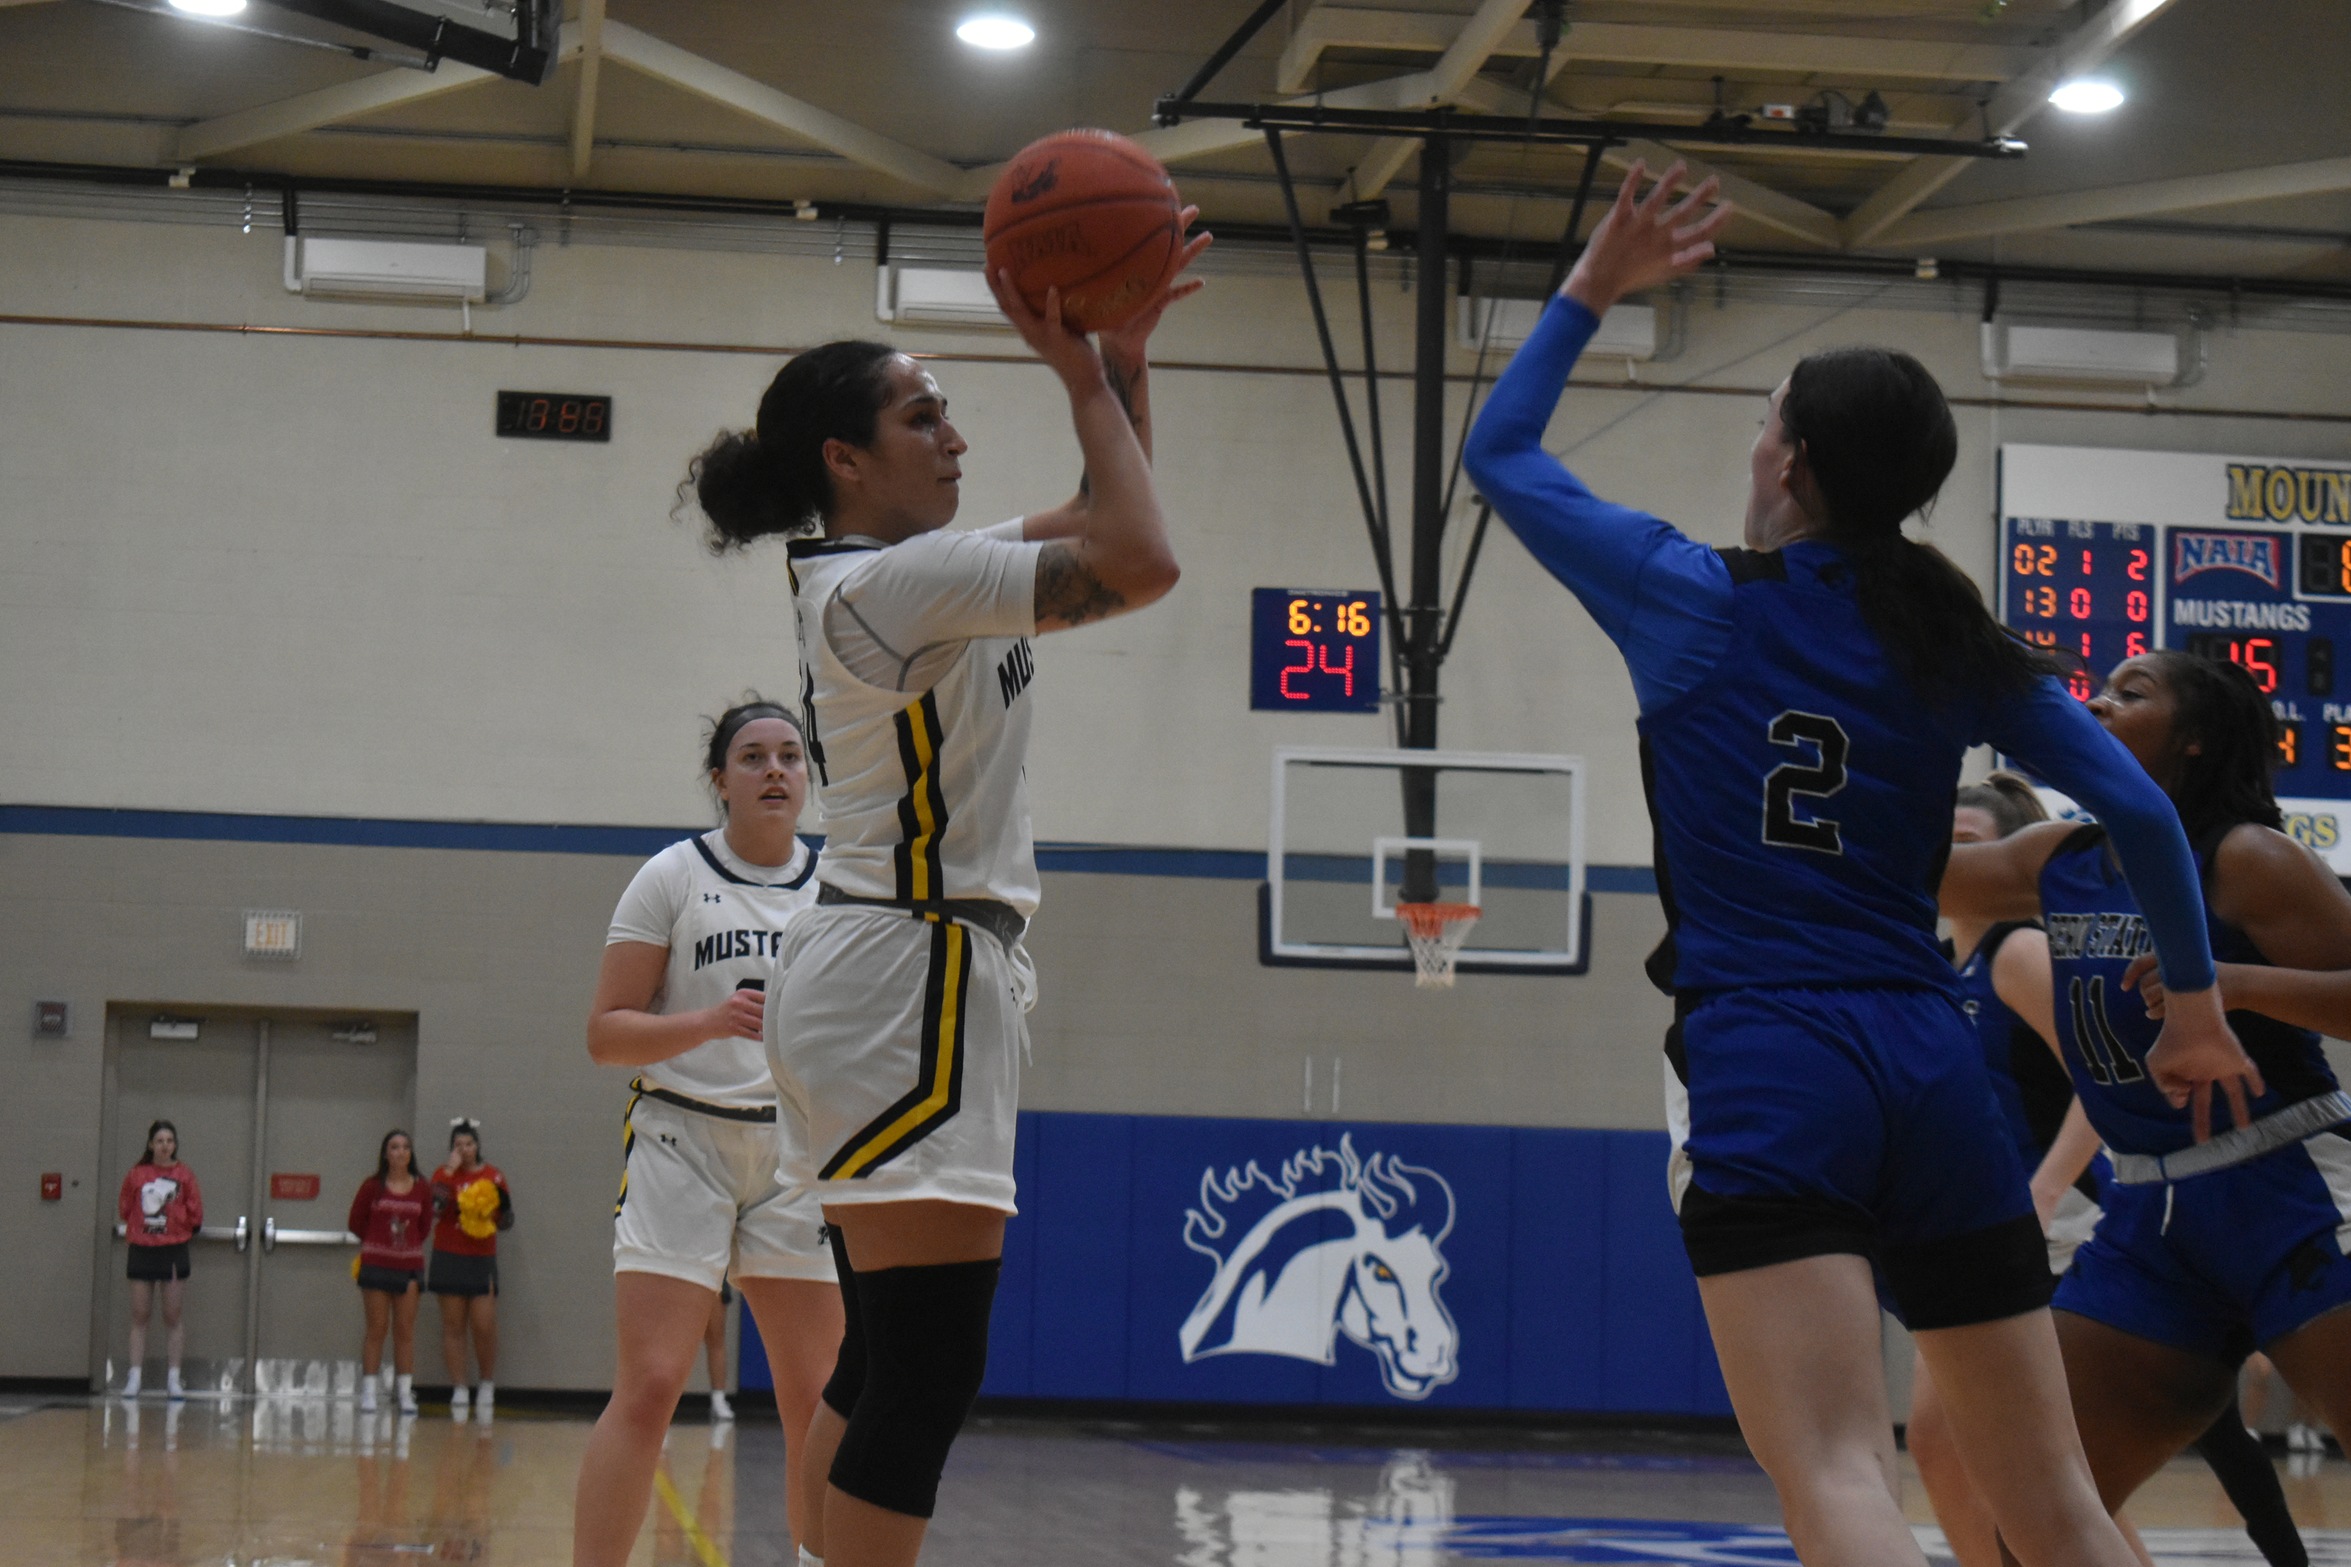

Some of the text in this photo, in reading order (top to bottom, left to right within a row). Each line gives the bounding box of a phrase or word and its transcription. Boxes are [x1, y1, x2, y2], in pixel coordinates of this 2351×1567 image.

[2014, 543, 2148, 581] 02 1 2
[2178, 535, 2277, 581] NAIA
[1288, 599, 1371, 637] 6:16
[2025, 581, 2147, 622] 13 0 0
[2173, 599, 2311, 632] MUSTANGS
[2081, 632, 2091, 658] 1
[1280, 639, 1354, 700] 24
[1762, 709, 1850, 856] 2
[2069, 975, 2145, 1086] 11
